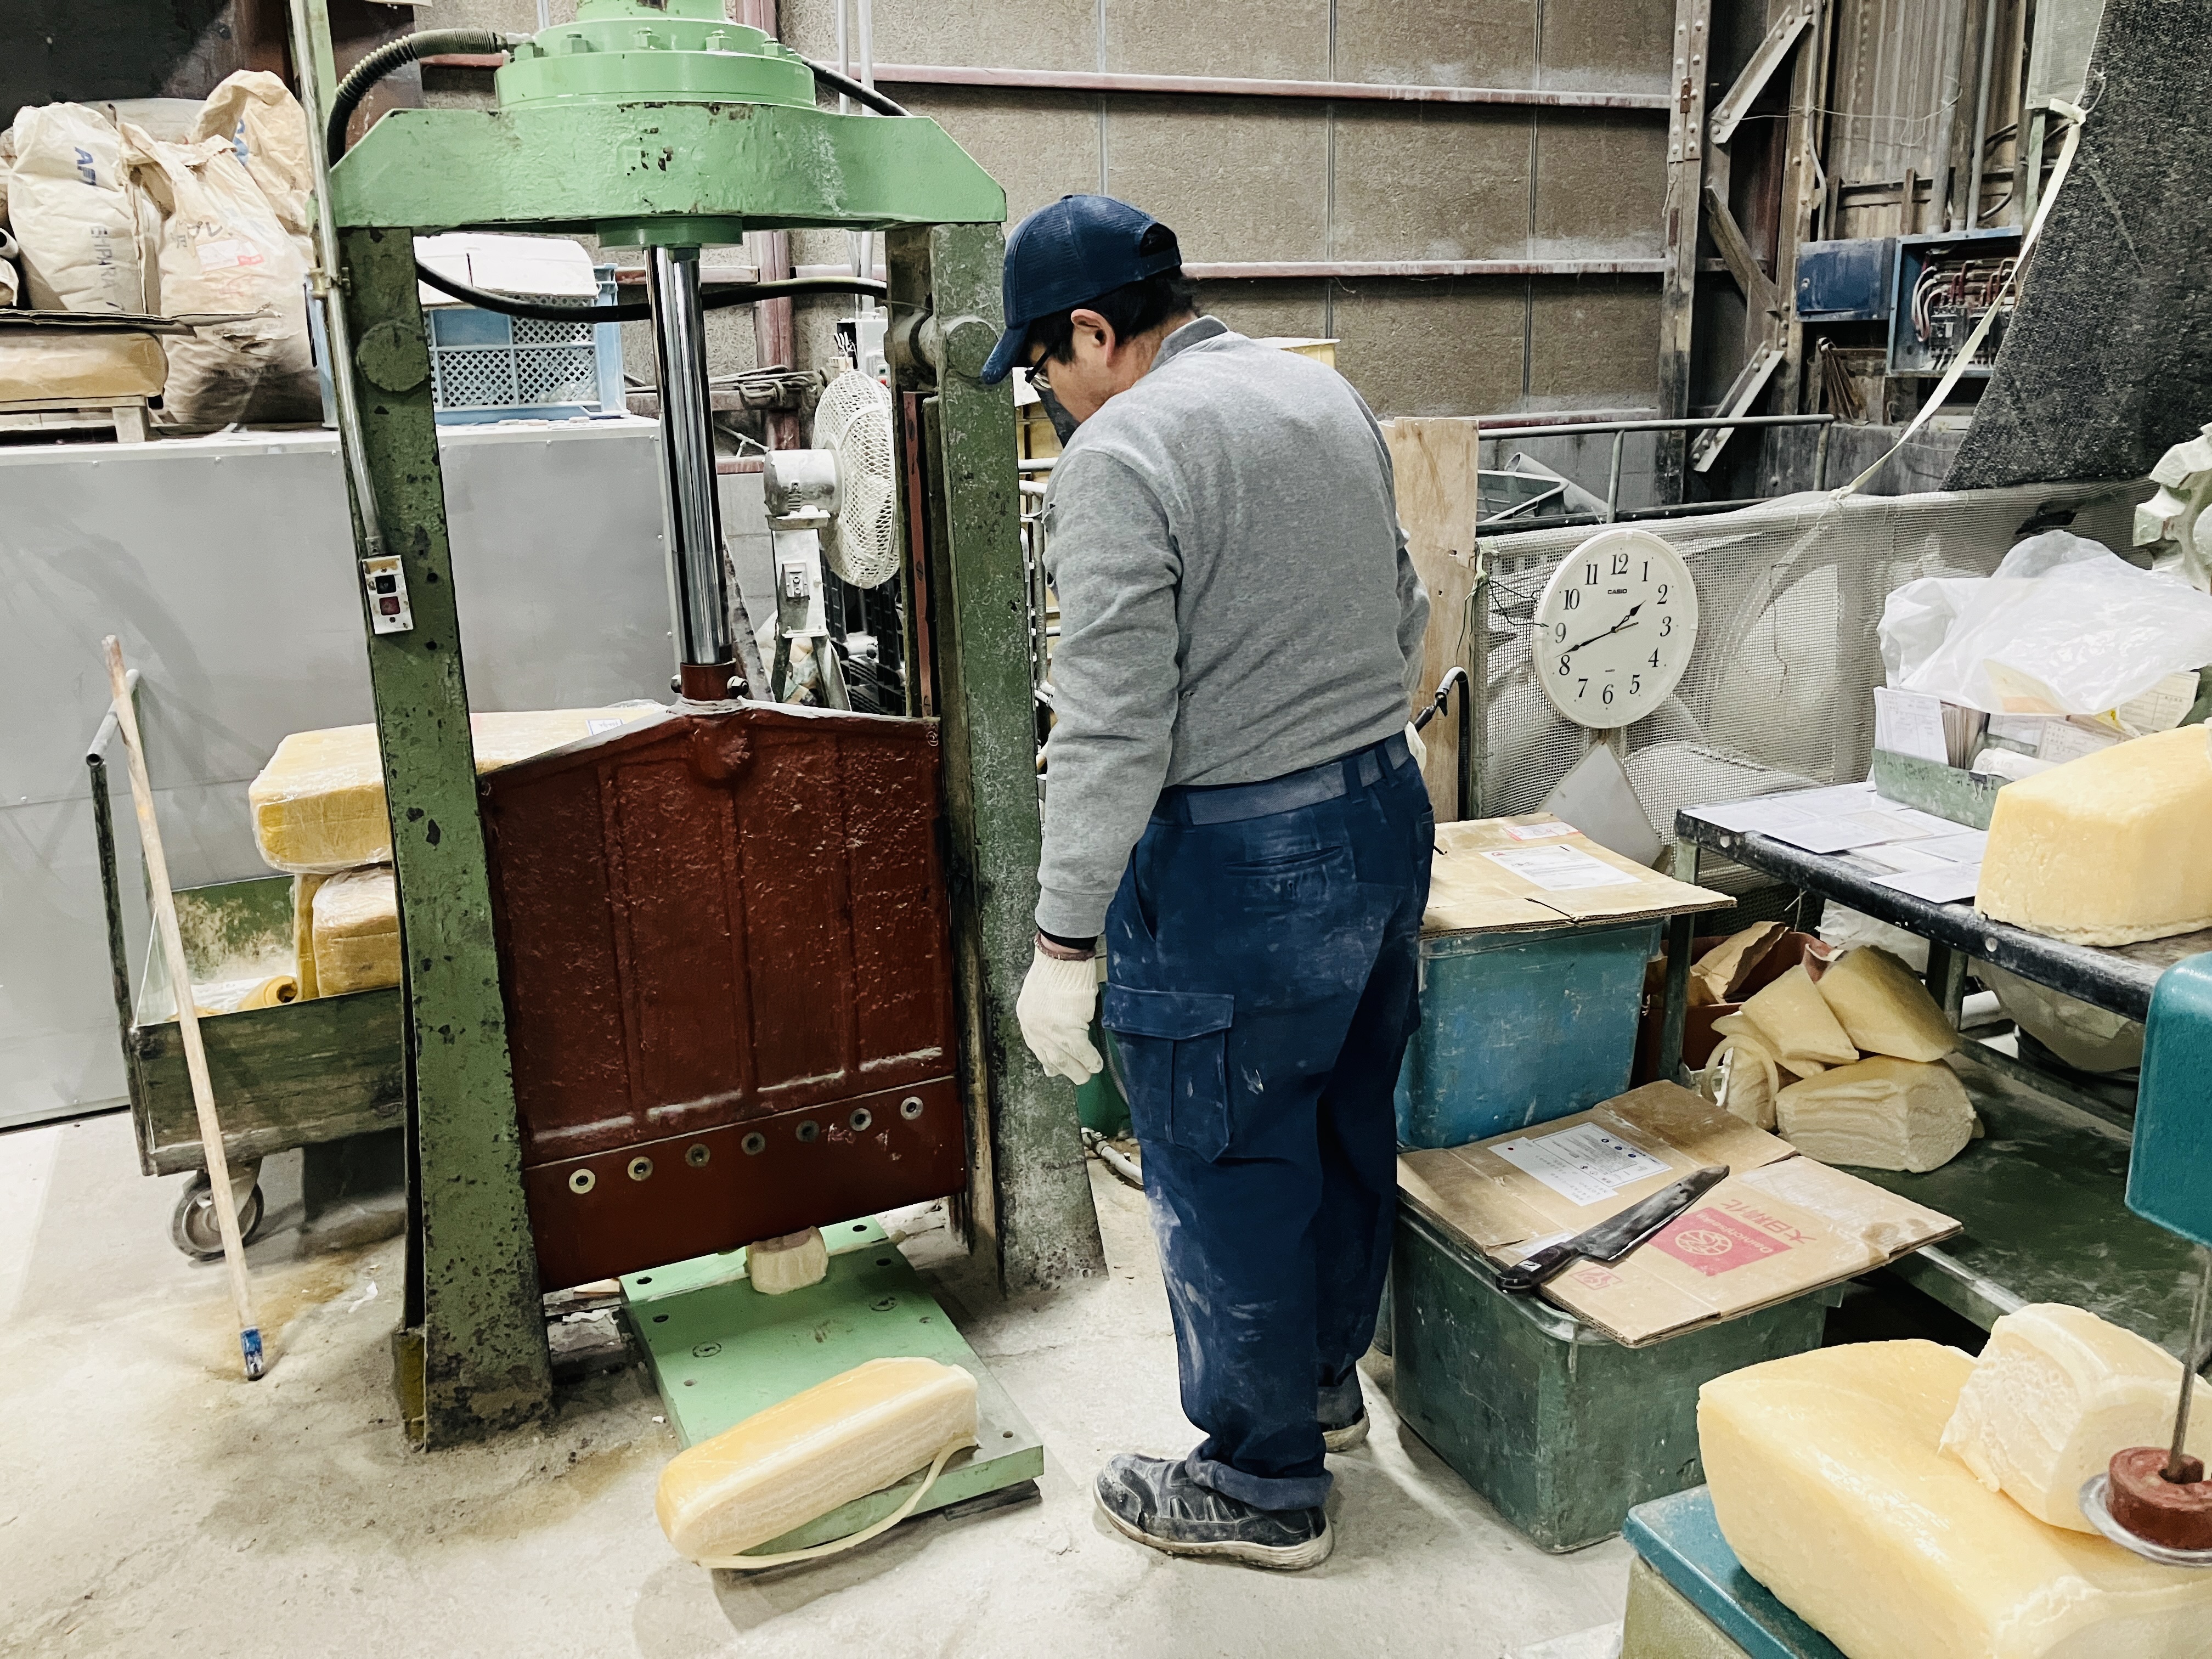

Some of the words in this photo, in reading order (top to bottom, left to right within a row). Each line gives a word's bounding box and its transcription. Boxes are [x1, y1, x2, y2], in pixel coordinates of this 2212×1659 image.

[1584, 563, 1598, 585] 11
[1610, 553, 1629, 575] 12
[1641, 561, 1648, 582] 1
[1562, 588, 1580, 611] 10
[1656, 584, 1668, 605] 2
[1555, 622, 1566, 644] 9
[1660, 616, 1672, 637] 3
[1559, 654, 1570, 676] 8
[1647, 647, 1659, 668] 4
[1578, 678, 1589, 698] 7
[1602, 684, 1614, 704] 6
[1629, 674, 1640, 695] 5
[1720, 1199, 1816, 1244] 大日精化
[1696, 1213, 1774, 1254] Dainichiseika
